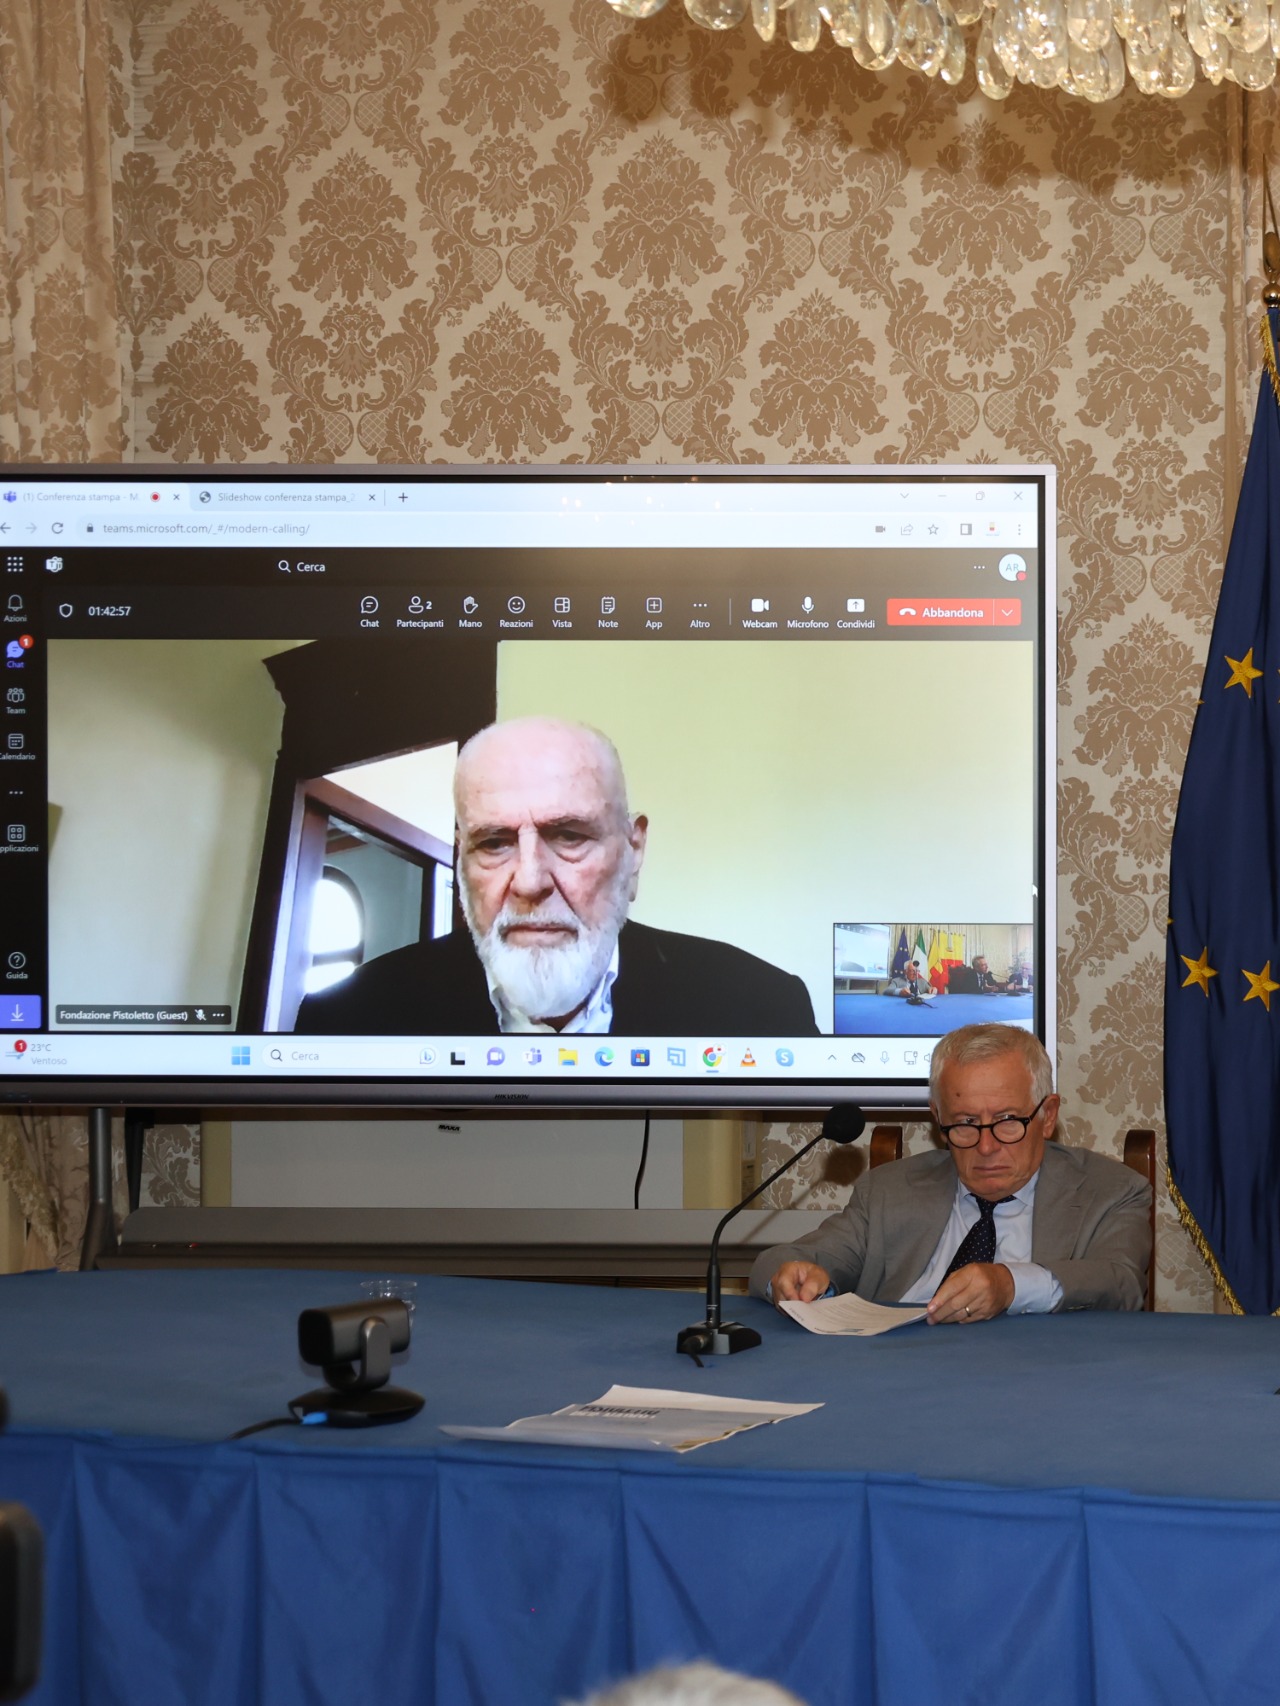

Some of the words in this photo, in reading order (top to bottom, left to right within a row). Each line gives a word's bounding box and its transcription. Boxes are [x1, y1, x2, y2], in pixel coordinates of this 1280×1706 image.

[23, 492, 34, 502] (1)
[37, 492, 86, 501] Conferenza
[88, 493, 121, 503] stampa
[218, 492, 261, 501] Slideshow
[264, 492, 312, 501] conferenza
[296, 562, 326, 572] Cerca
[425, 601, 432, 610] 2
[88, 606, 131, 616] 01:42:57
[922, 607, 984, 619] Abbandona
[360, 619, 380, 628] Chat
[396, 619, 444, 630] Partecipanti
[458, 619, 482, 628] Mano
[499, 619, 533, 628] Reazioni
[552, 619, 572, 628] Vista
[598, 619, 618, 628] Note
[645, 619, 662, 630] App
[690, 619, 710, 628] Altro
[742, 619, 778, 629] Webcam
[787, 619, 829, 629] Microfono
[836, 619, 875, 629] Condividi
[6, 660, 24, 668] Chat
[0, 844, 39, 854] pplicazioni
[6, 972, 28, 980] Guida
[60, 1010, 111, 1020] Fondazione
[113, 1010, 154, 1020] Pistoletto
[156, 1010, 188, 1022] (Guest)
[31, 1043, 52, 1052] 23°C
[291, 1051, 320, 1061] Cerca
[31, 1057, 68, 1065] Ventoso
